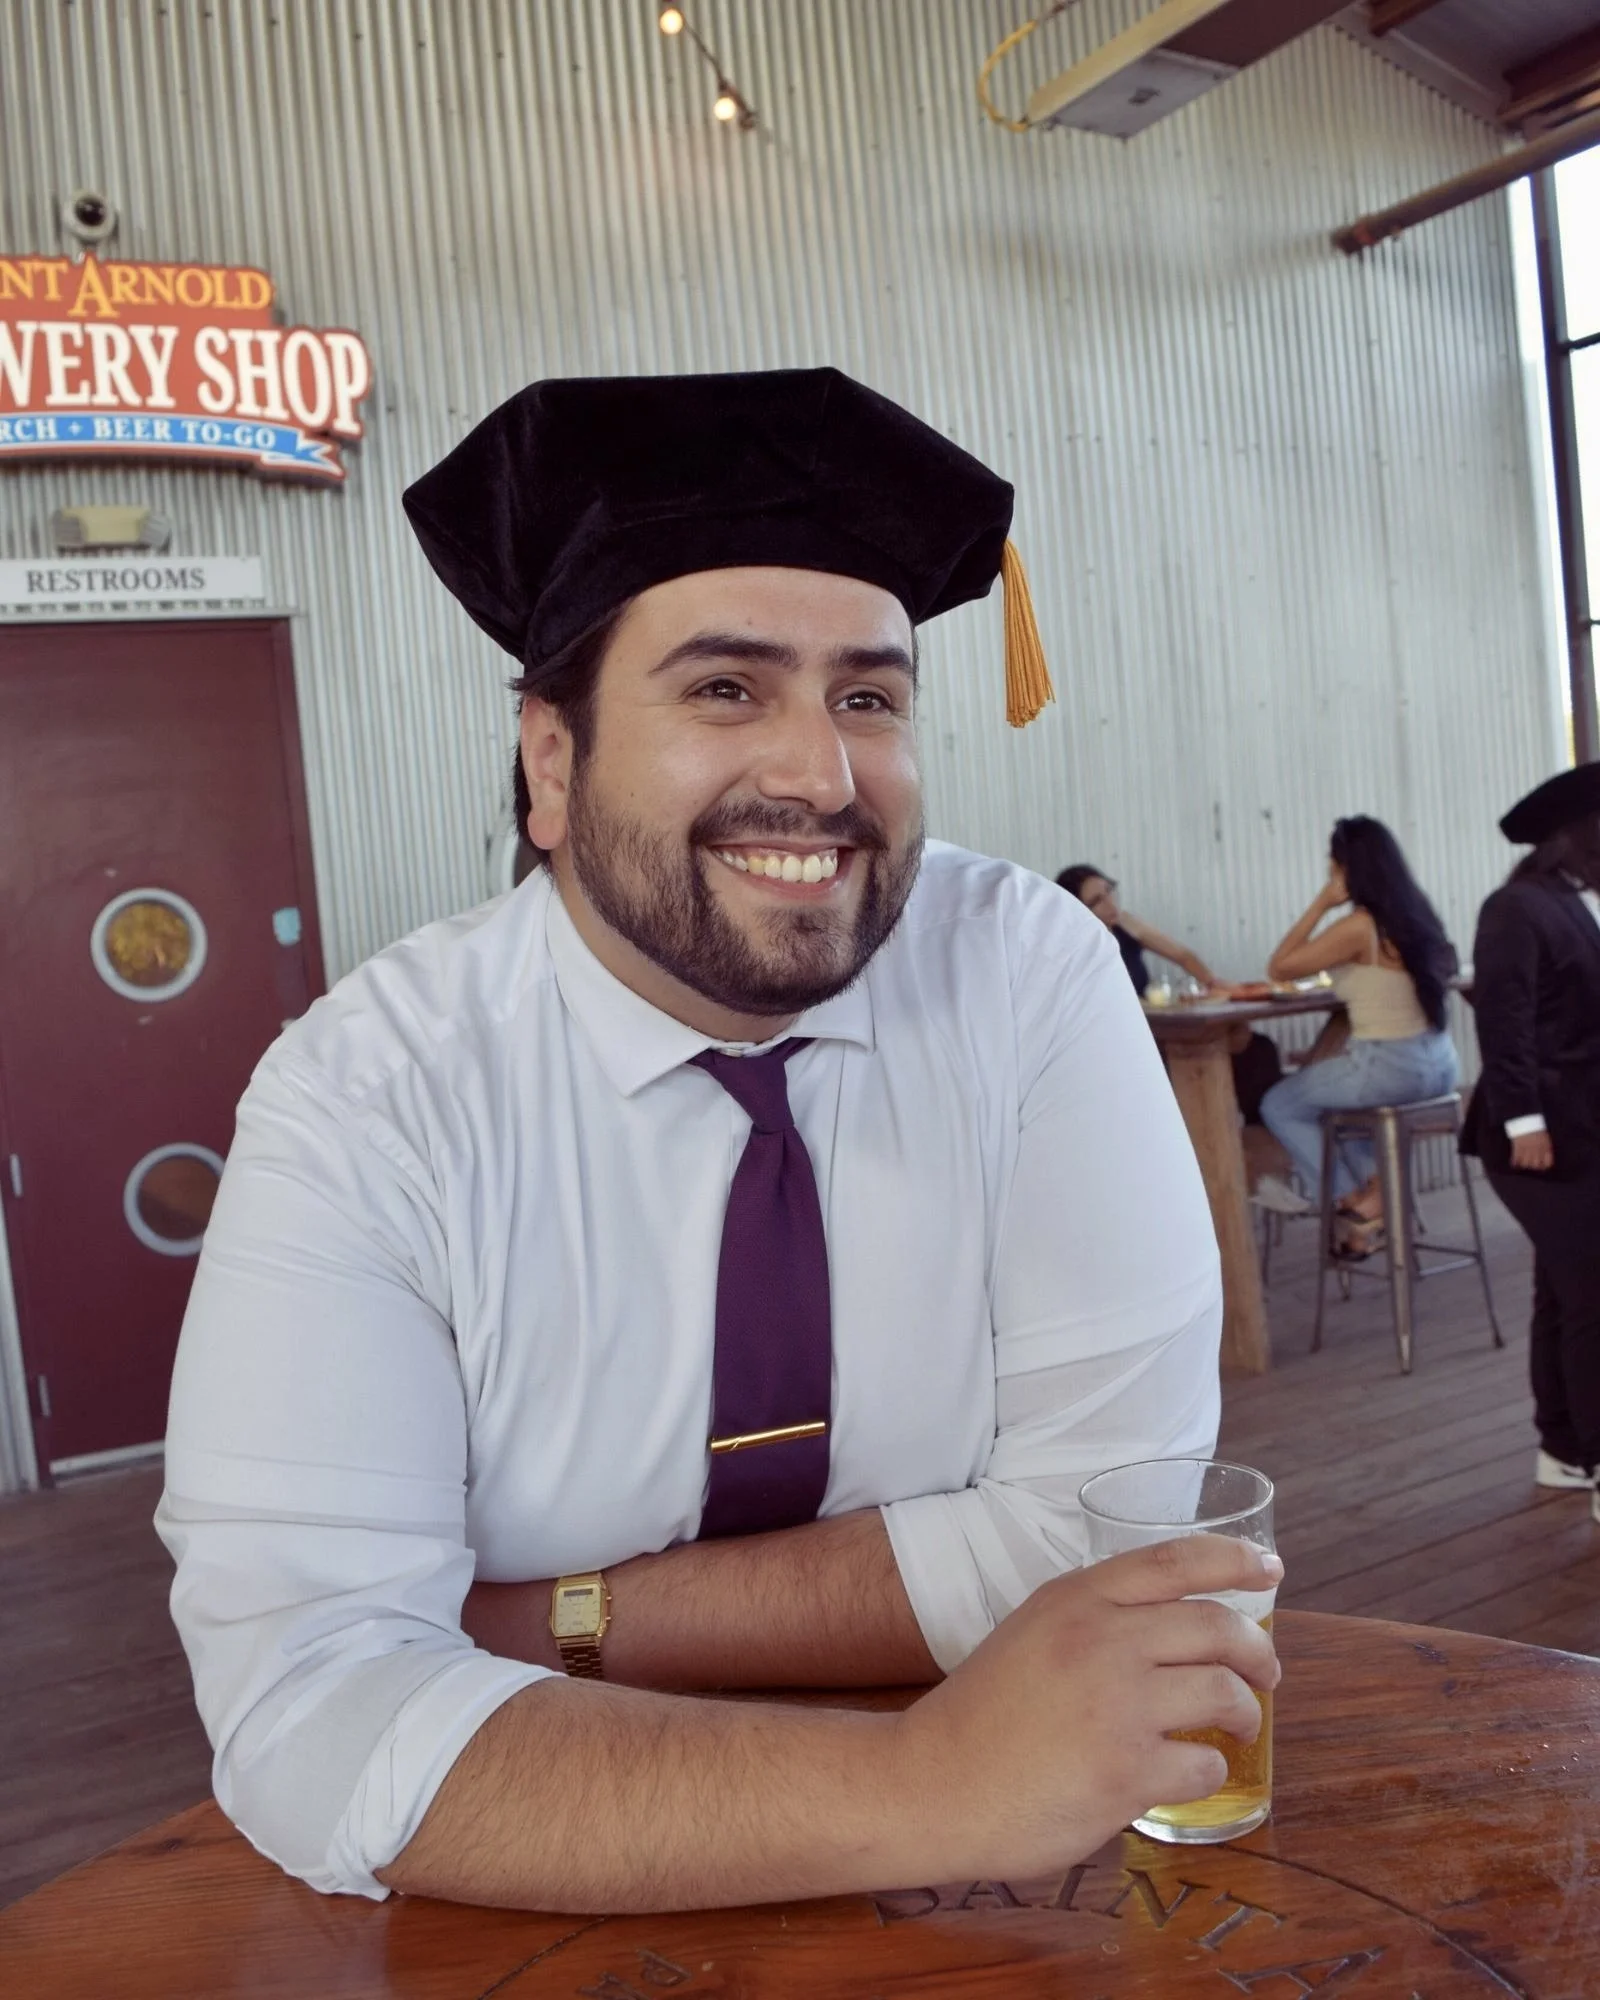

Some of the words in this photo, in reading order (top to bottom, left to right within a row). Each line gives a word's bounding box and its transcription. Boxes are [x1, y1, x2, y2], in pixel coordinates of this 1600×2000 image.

[0, 259, 69, 300] NT
[67, 255, 272, 318] ARNOLD
[194, 326, 369, 434] SHOP
[93, 417, 172, 440] BEER
[181, 420, 276, 448] TO-GO
[26, 567, 206, 594] RESTROOMS
